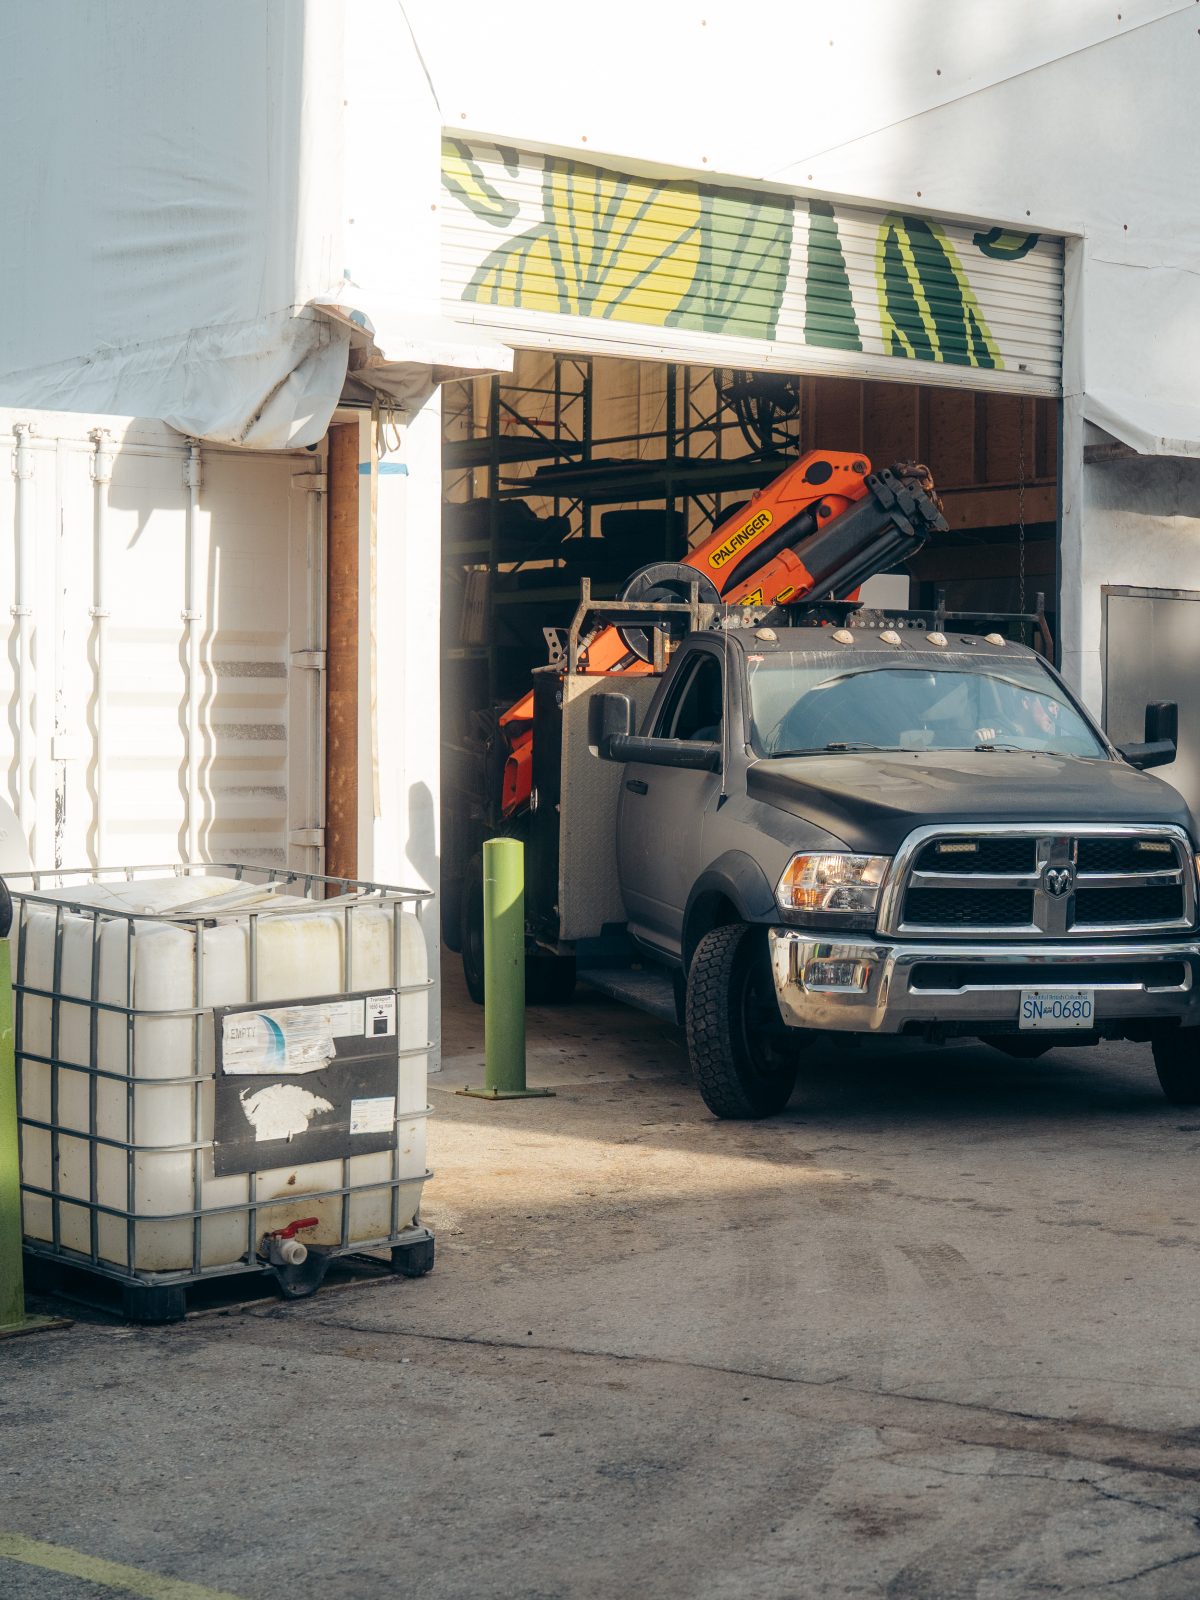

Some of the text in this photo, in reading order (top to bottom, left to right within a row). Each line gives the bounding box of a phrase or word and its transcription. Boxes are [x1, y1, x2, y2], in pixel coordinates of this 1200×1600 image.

[711, 513, 770, 566] PALFINGER
[1023, 1000, 1092, 1019] SN 0680
